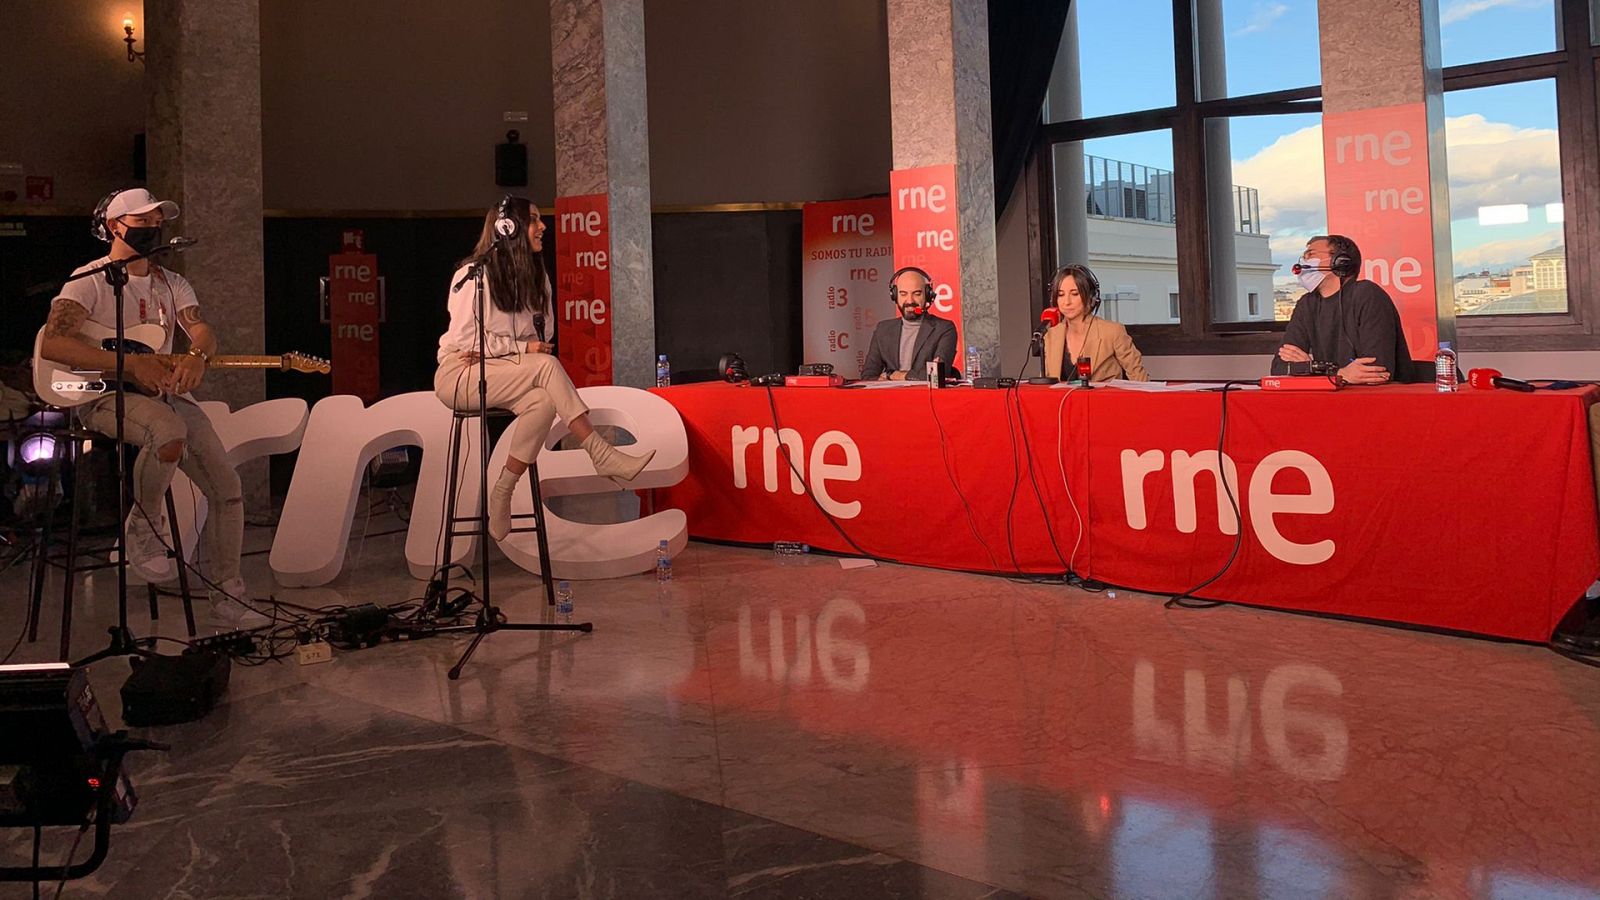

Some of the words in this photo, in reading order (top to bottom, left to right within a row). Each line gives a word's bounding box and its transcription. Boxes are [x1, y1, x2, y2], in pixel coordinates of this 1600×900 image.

[1335, 129, 1412, 167] rne
[898, 183, 947, 214] rne
[1364, 186, 1425, 215] rne
[561, 210, 601, 237] rne
[832, 213, 875, 236] rne
[916, 229, 955, 251] rne
[576, 250, 608, 270] rne
[811, 249, 846, 261] SOMOS
[849, 248, 863, 259] TU
[865, 247, 894, 258] RADI
[335, 264, 371, 282] rne
[850, 267, 878, 282] rne
[1364, 256, 1423, 293] ne
[348, 291, 376, 305] rne
[827, 286, 835, 310] radio
[836, 288, 848, 307] 3
[565, 299, 606, 325] rne
[338, 324, 374, 341] rne
[828, 330, 836, 352] radio
[837, 333, 849, 349] C
[1265, 379, 1281, 388] rne
[731, 424, 862, 519] rne
[1120, 449, 1336, 565] rne
